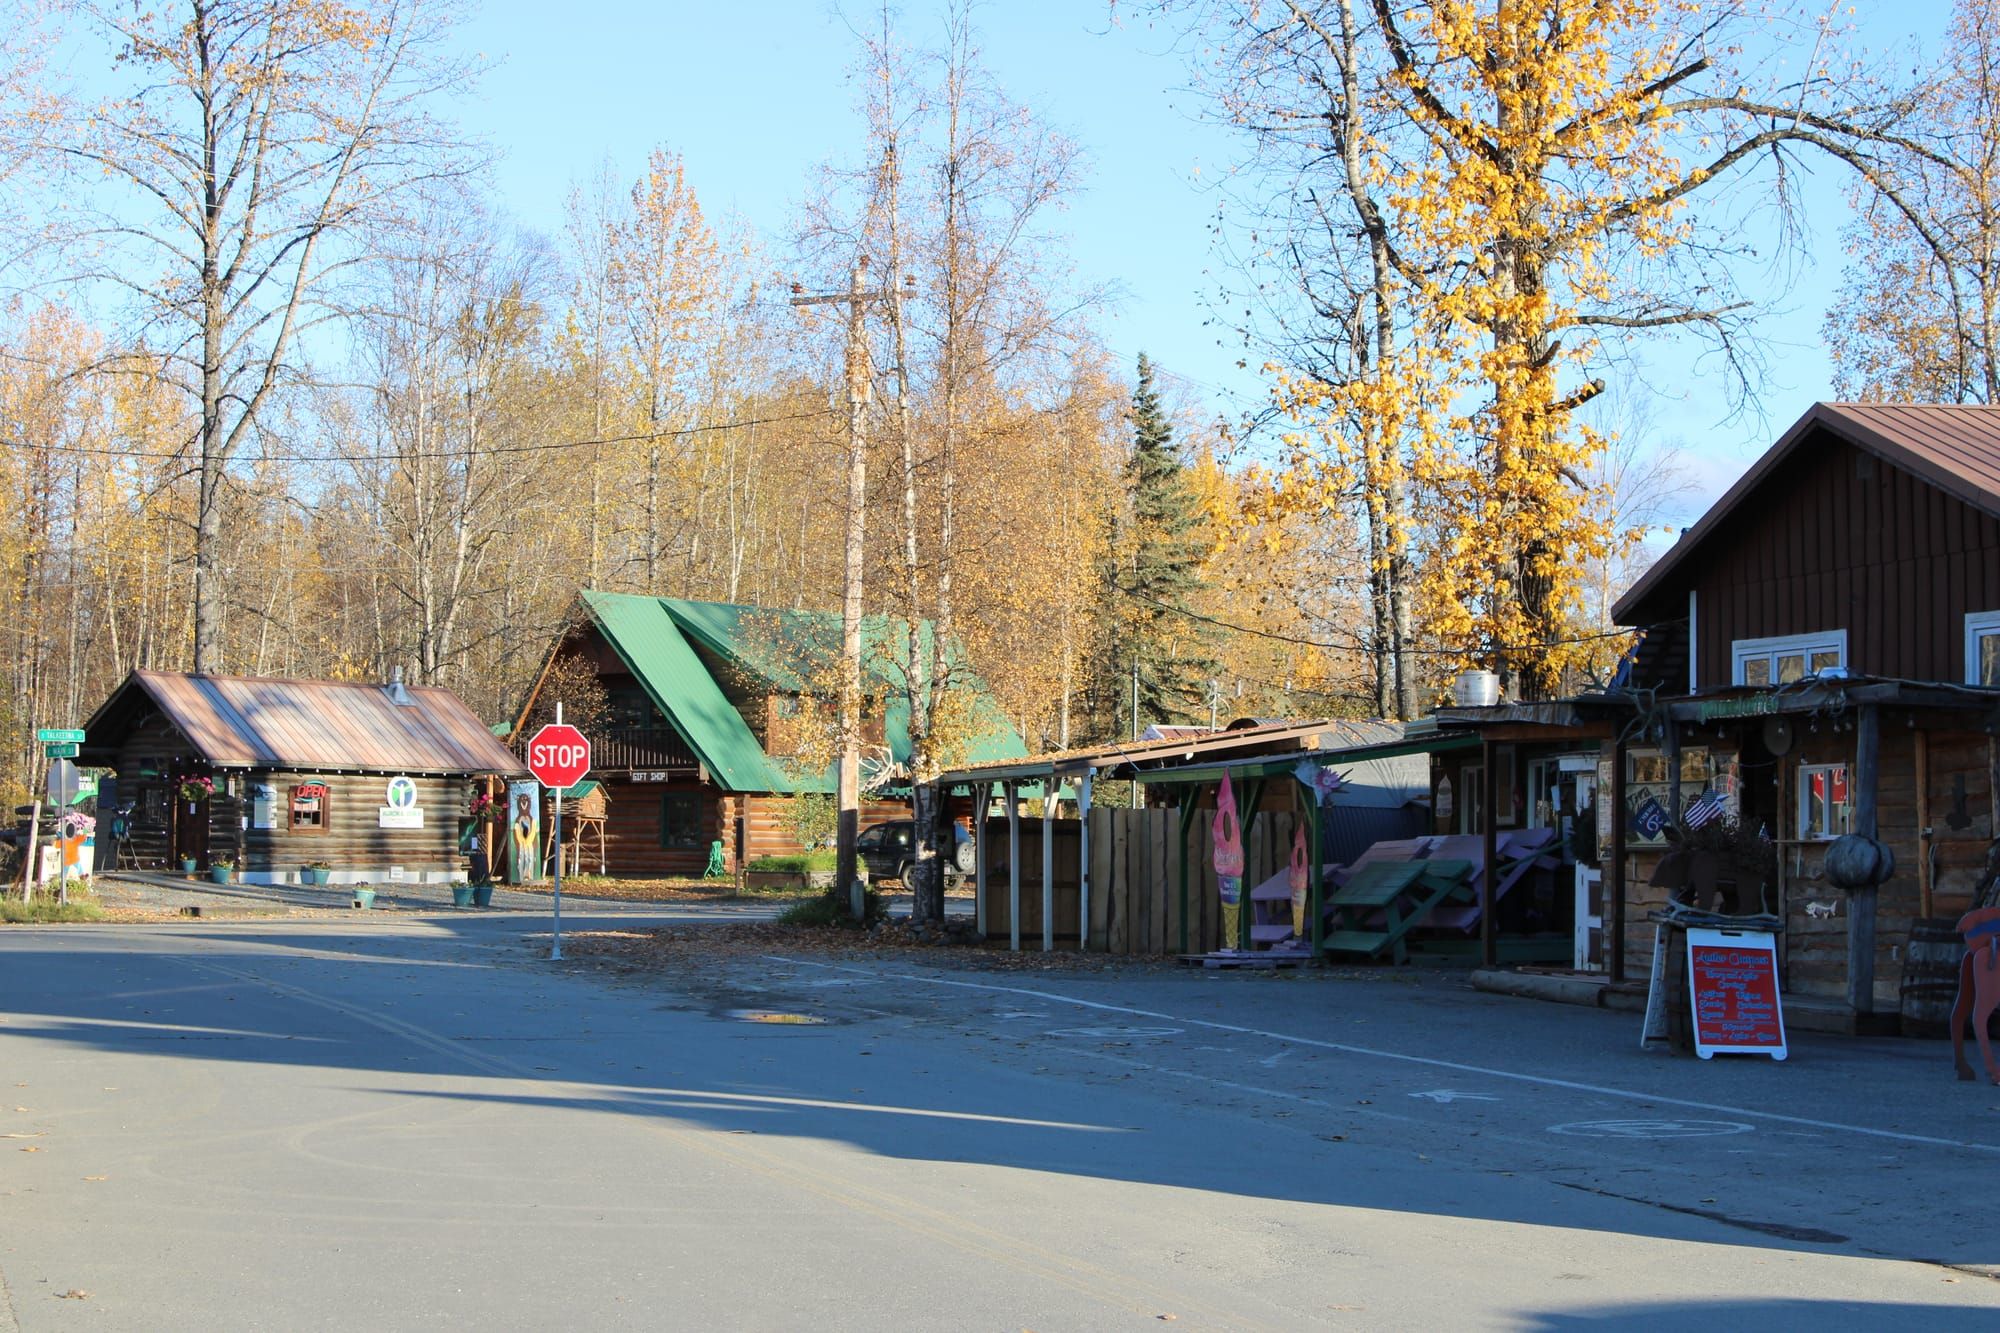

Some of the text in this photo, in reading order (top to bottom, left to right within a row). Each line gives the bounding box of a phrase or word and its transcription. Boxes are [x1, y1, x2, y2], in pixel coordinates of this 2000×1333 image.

[533, 744, 586, 769] STOP
[632, 772, 666, 781] GIFT SHOP
[297, 785, 327, 798] OPEN
